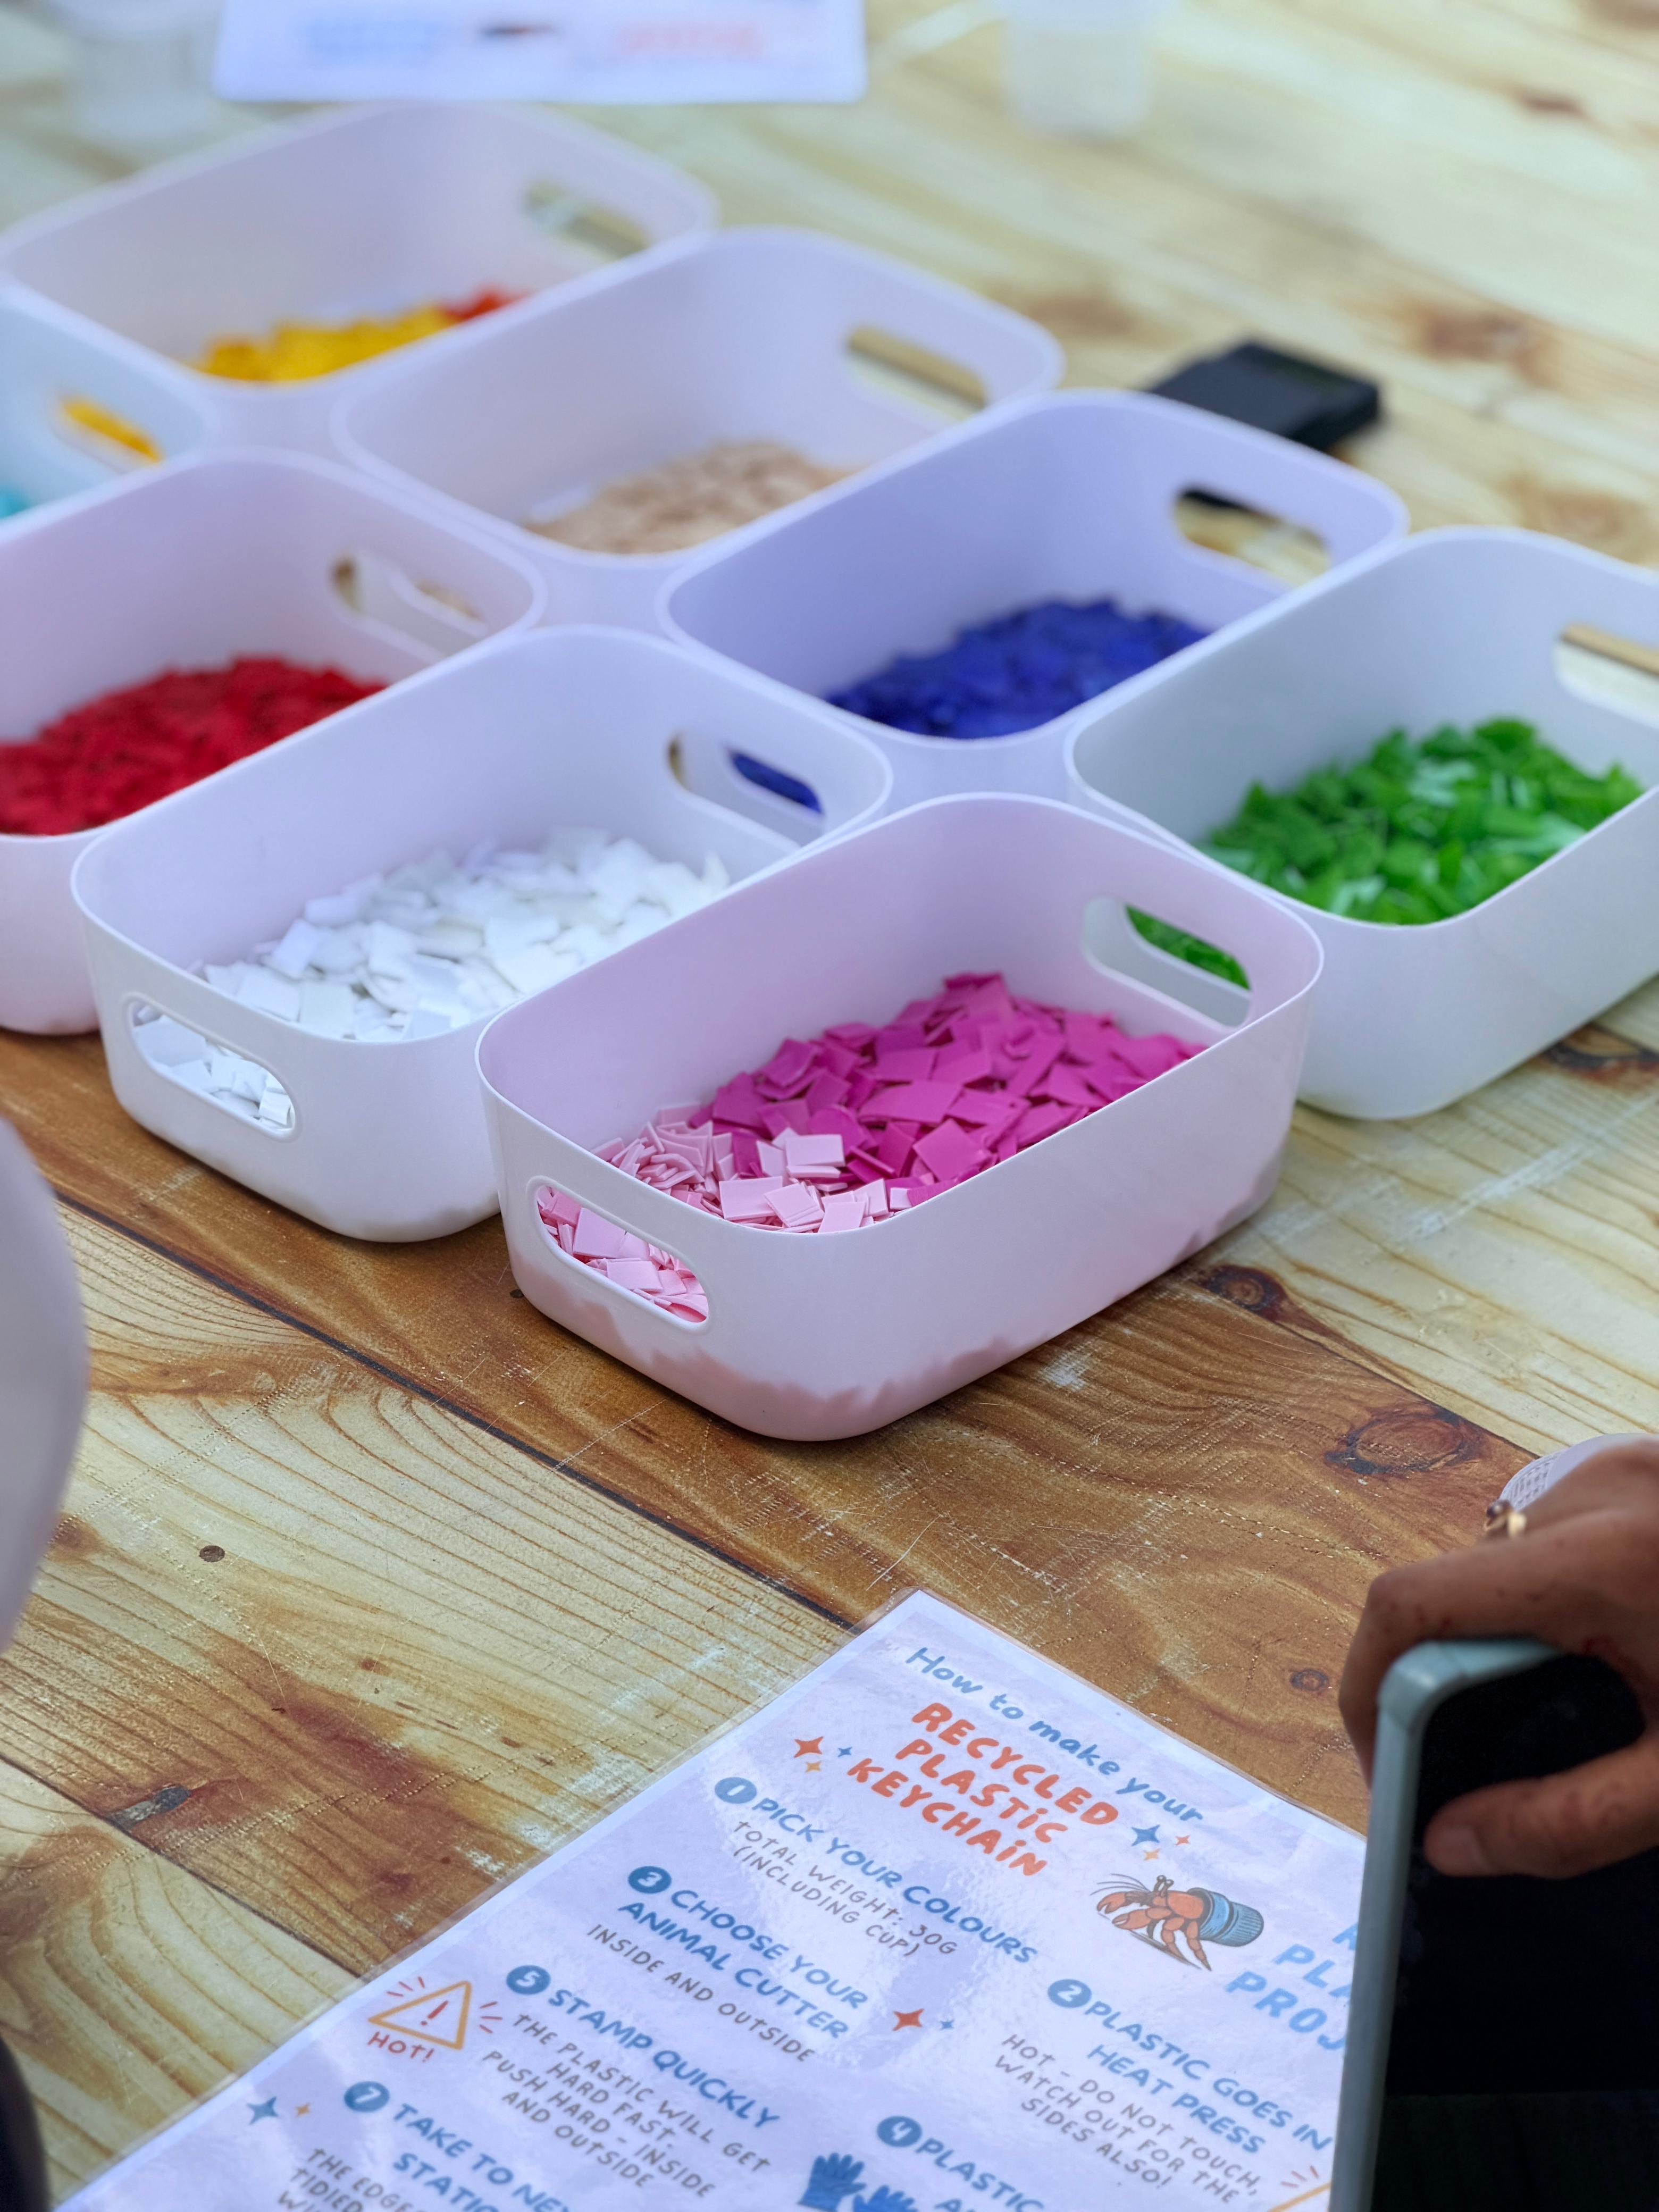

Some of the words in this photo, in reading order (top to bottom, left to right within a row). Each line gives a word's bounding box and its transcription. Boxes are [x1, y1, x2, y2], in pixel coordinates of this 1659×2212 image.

[906, 1647, 983, 1694] How
[990, 1694, 1024, 1719] to
[1028, 1720, 1120, 1775] make
[1116, 1778, 1203, 1821] your
[912, 1703, 1118, 1824] RECYCLED
[734, 1821, 798, 1865] TOTAL
[909, 1925, 958, 1955] 30G
[734, 1846, 859, 1923] (INCLUDING
[865, 1924, 919, 1957] CUP)
[752, 1798, 824, 1842] PICK
[826, 1837, 902, 1888] YOUR
[904, 1886, 1037, 1963] COLOURS
[588, 1924, 664, 1973] INSIDE
[665, 1972, 714, 2001] AND
[718, 2003, 815, 2062] OUTSIDE
[618, 1903, 731, 1971] ANIMAL
[735, 1968, 849, 2039] CUTTER
[672, 1890, 789, 1960] CHOOSE
[791, 1955, 868, 2008] YOUR
[367, 2031, 434, 2063] HOT!
[513, 2014, 557, 2045] THE
[558, 2042, 654, 2102] PLASTIC
[658, 2100, 714, 2143] WILL
[722, 2143, 770, 2172] GET
[547, 2063, 609, 2104] HARD
[613, 2102, 675, 2148] FAST.
[548, 1989, 653, 2049] STAMP
[653, 2050, 780, 2127] QUICKLY
[1085, 2000, 1211, 2081] PLASTIC
[1212, 2077, 1293, 2129] GOES
[1292, 2124, 1333, 2150] IN
[1087, 2045, 1173, 2096] HEAT
[1172, 2093, 1266, 2154] PRESS
[393, 2104, 472, 2158] TAKE
[472, 2153, 514, 2185] TO
[512, 2184, 569, 2212] NE
[482, 2051, 548, 2092] PUSH
[548, 2091, 610, 2133] HARD
[634, 2144, 715, 2198] INSIDE
[502, 2092, 550, 2123] AND
[555, 2125, 654, 2187] OUTSIDE
[915, 2138, 1045, 2212] PLASTIC
[995, 2055, 1082, 2109] WATCH
[1084, 2109, 1135, 2140] OUT
[1137, 2139, 1185, 2173] FOR
[1190, 2171, 1241, 2204] THE
[1002, 2034, 1055, 2068] HOT
[1079, 2079, 1116, 2104] DO
[1120, 2102, 1174, 2137] NOT
[1179, 2136, 1262, 2196] TOUCH,
[1021, 2098, 1095, 2143] SIDES
[1096, 2142, 1172, 2189] ALSO!
[308, 2148, 353, 2180] THE
[352, 2177, 427, 2212] EDGE
